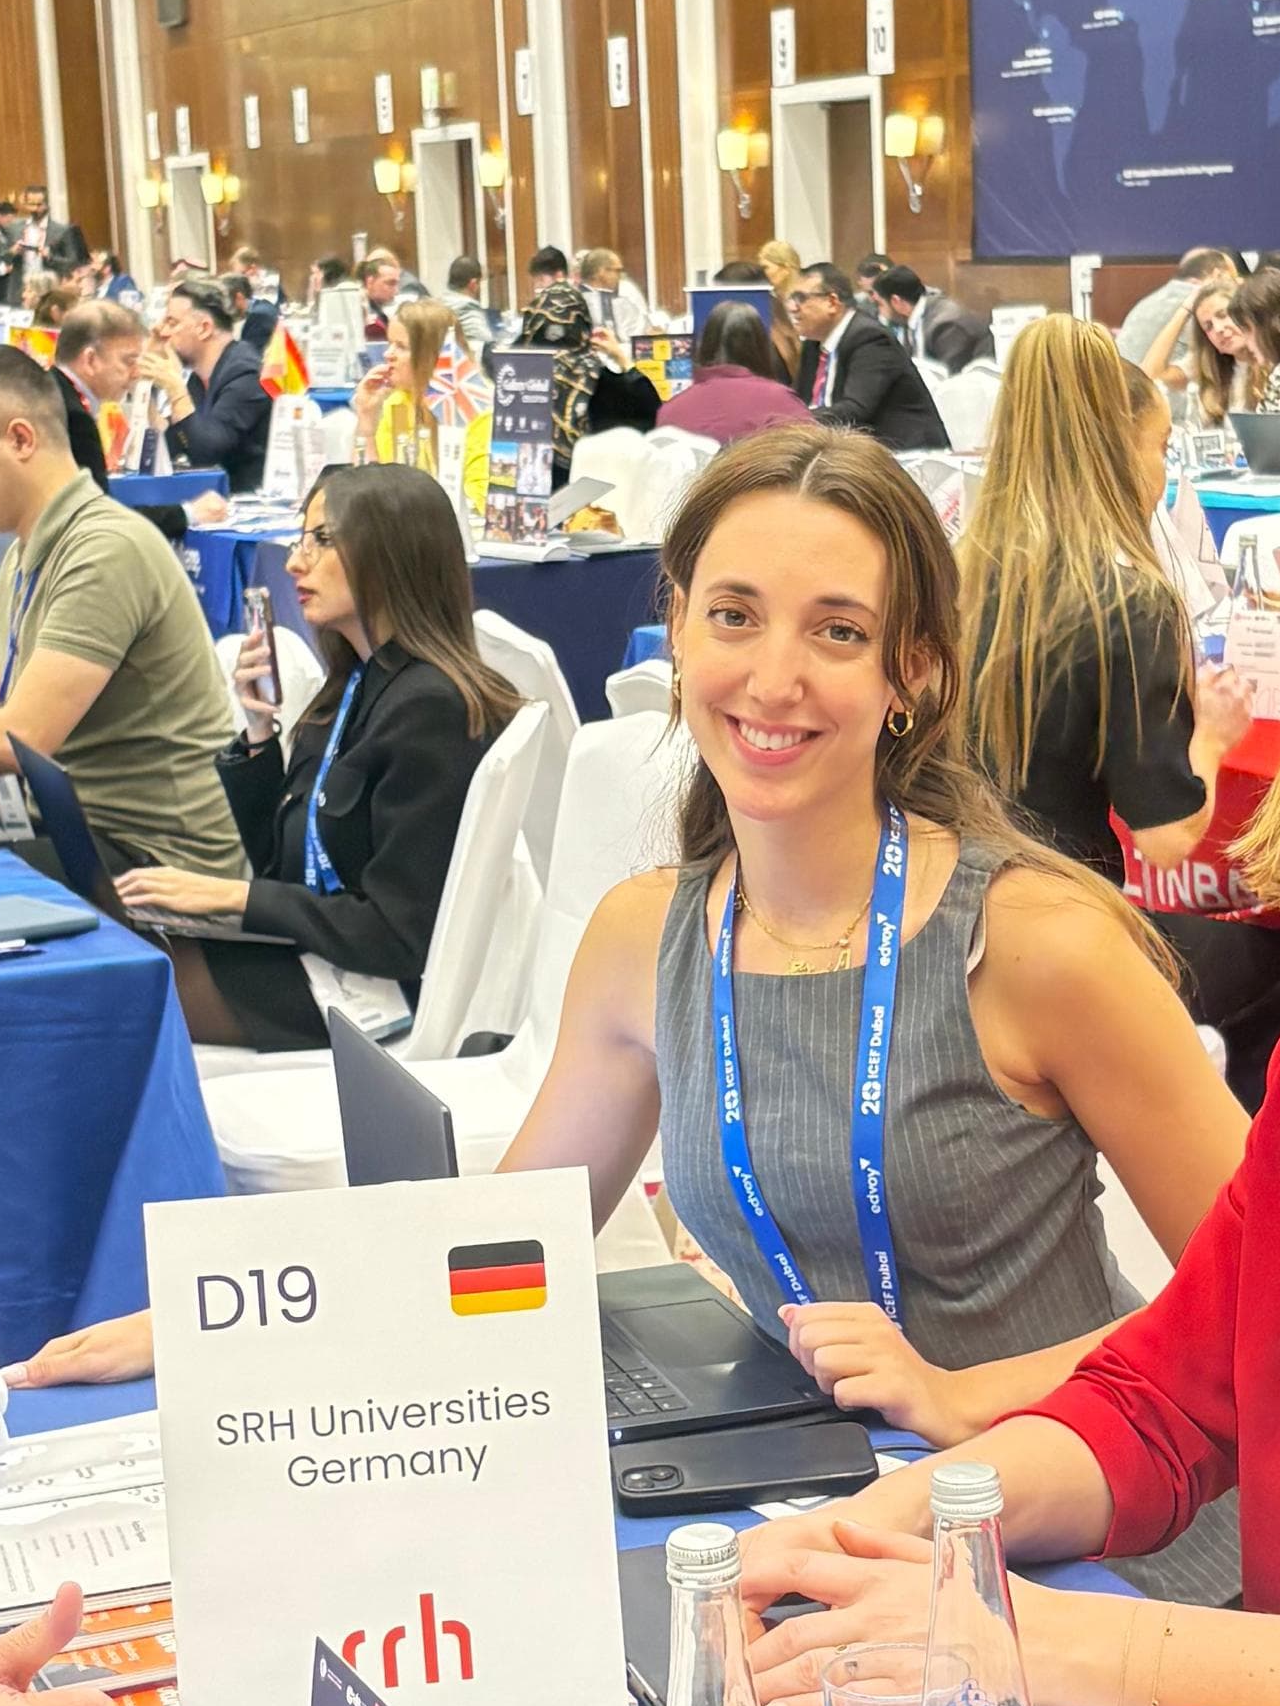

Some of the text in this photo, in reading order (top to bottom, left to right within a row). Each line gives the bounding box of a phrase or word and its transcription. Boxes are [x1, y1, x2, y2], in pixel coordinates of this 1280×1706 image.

[883, 844, 904, 878] 20
[877, 921, 897, 968] edvoy
[721, 1014, 733, 1056] Dubai
[861, 1005, 885, 1116] 20 ICEF Dubai
[724, 1088, 741, 1125] 20
[740, 1172, 764, 1218] edvoy
[866, 1166, 882, 1214] edvoy
[774, 1253, 803, 1298] Dubai
[874, 1250, 893, 1290] Dubai
[197, 1265, 317, 1332] D19
[216, 1386, 551, 1446] SRH Universities
[287, 1443, 488, 1489] Germany
